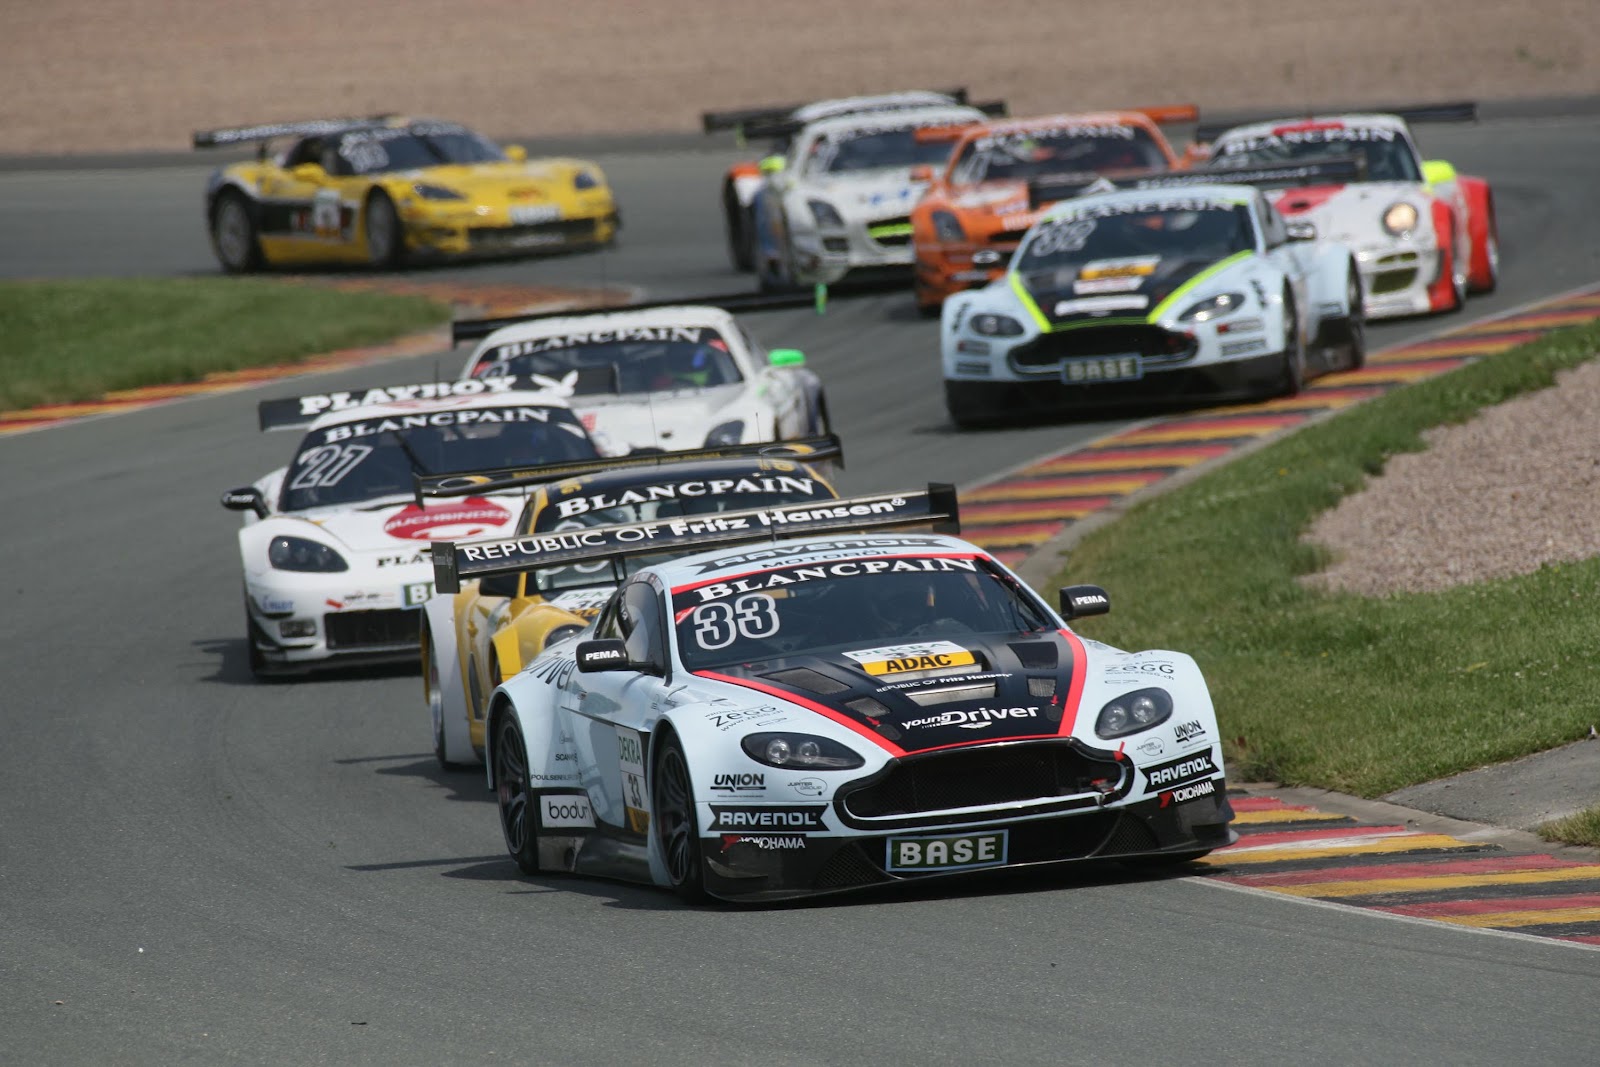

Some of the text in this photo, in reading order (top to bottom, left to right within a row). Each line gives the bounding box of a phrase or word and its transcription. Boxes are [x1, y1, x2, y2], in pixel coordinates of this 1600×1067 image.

[499, 326, 701, 361] BLANCPAIN
[1069, 358, 1134, 381] BASE
[324, 407, 551, 444] BLANCPAIN
[556, 475, 814, 519] BLANCPAIN
[463, 532, 606, 562] REPUBLIC
[615, 525, 661, 542] OF
[671, 515, 750, 537] Fritz
[713, 539, 929, 568] RAVENOL
[693, 556, 978, 602] BLANCPAIN
[1075, 594, 1108, 606] PEMA
[693, 592, 781, 651] 33
[585, 650, 621, 661] PEMA
[886, 654, 952, 673] ADAC
[876, 681, 922, 693] REPUBLIC
[923, 678, 936, 686] OF
[1173, 719, 1203, 738] UNION
[618, 735, 642, 765] DEKRA
[713, 773, 765, 788] UNION
[1150, 755, 1212, 786] RAVENOL
[627, 773, 643, 809] 33
[1172, 781, 1215, 803] YOKOHAMA
[719, 811, 817, 826] RAVENOL
[900, 837, 996, 865] BASE
